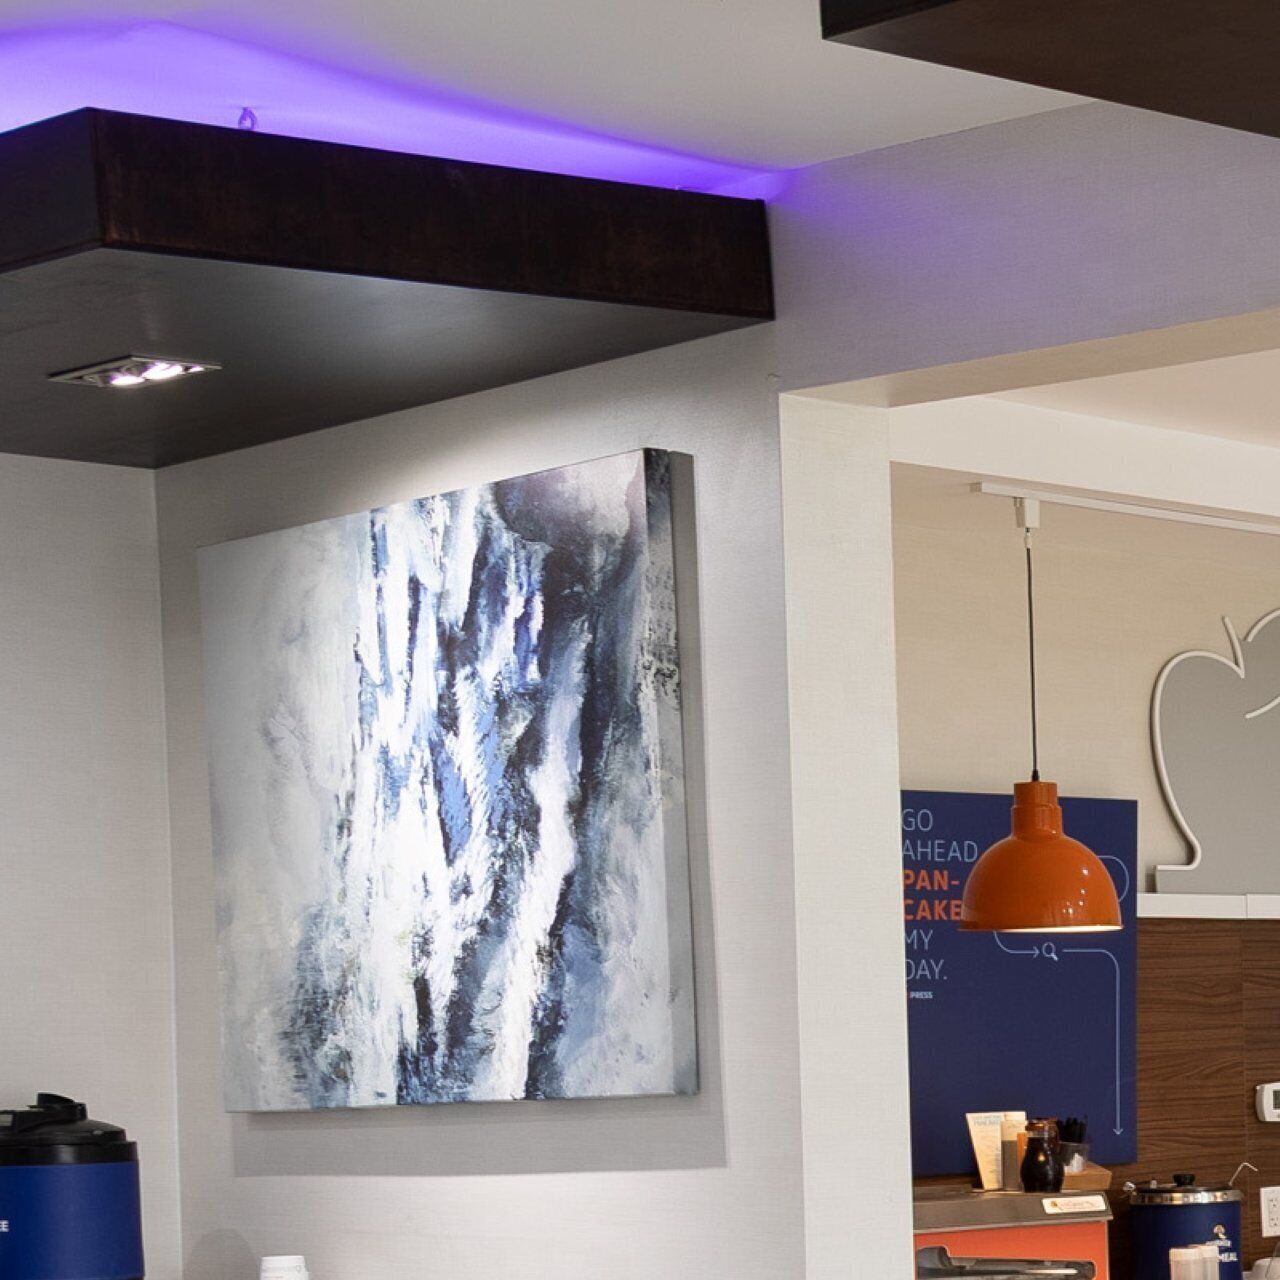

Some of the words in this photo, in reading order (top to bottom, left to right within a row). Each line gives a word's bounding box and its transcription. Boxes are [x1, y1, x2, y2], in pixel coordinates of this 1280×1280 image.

[902, 808, 933, 832] GO
[902, 839, 978, 863] AHEAD
[903, 869, 960, 891] PAN-
[903, 899, 961, 921] CAKE
